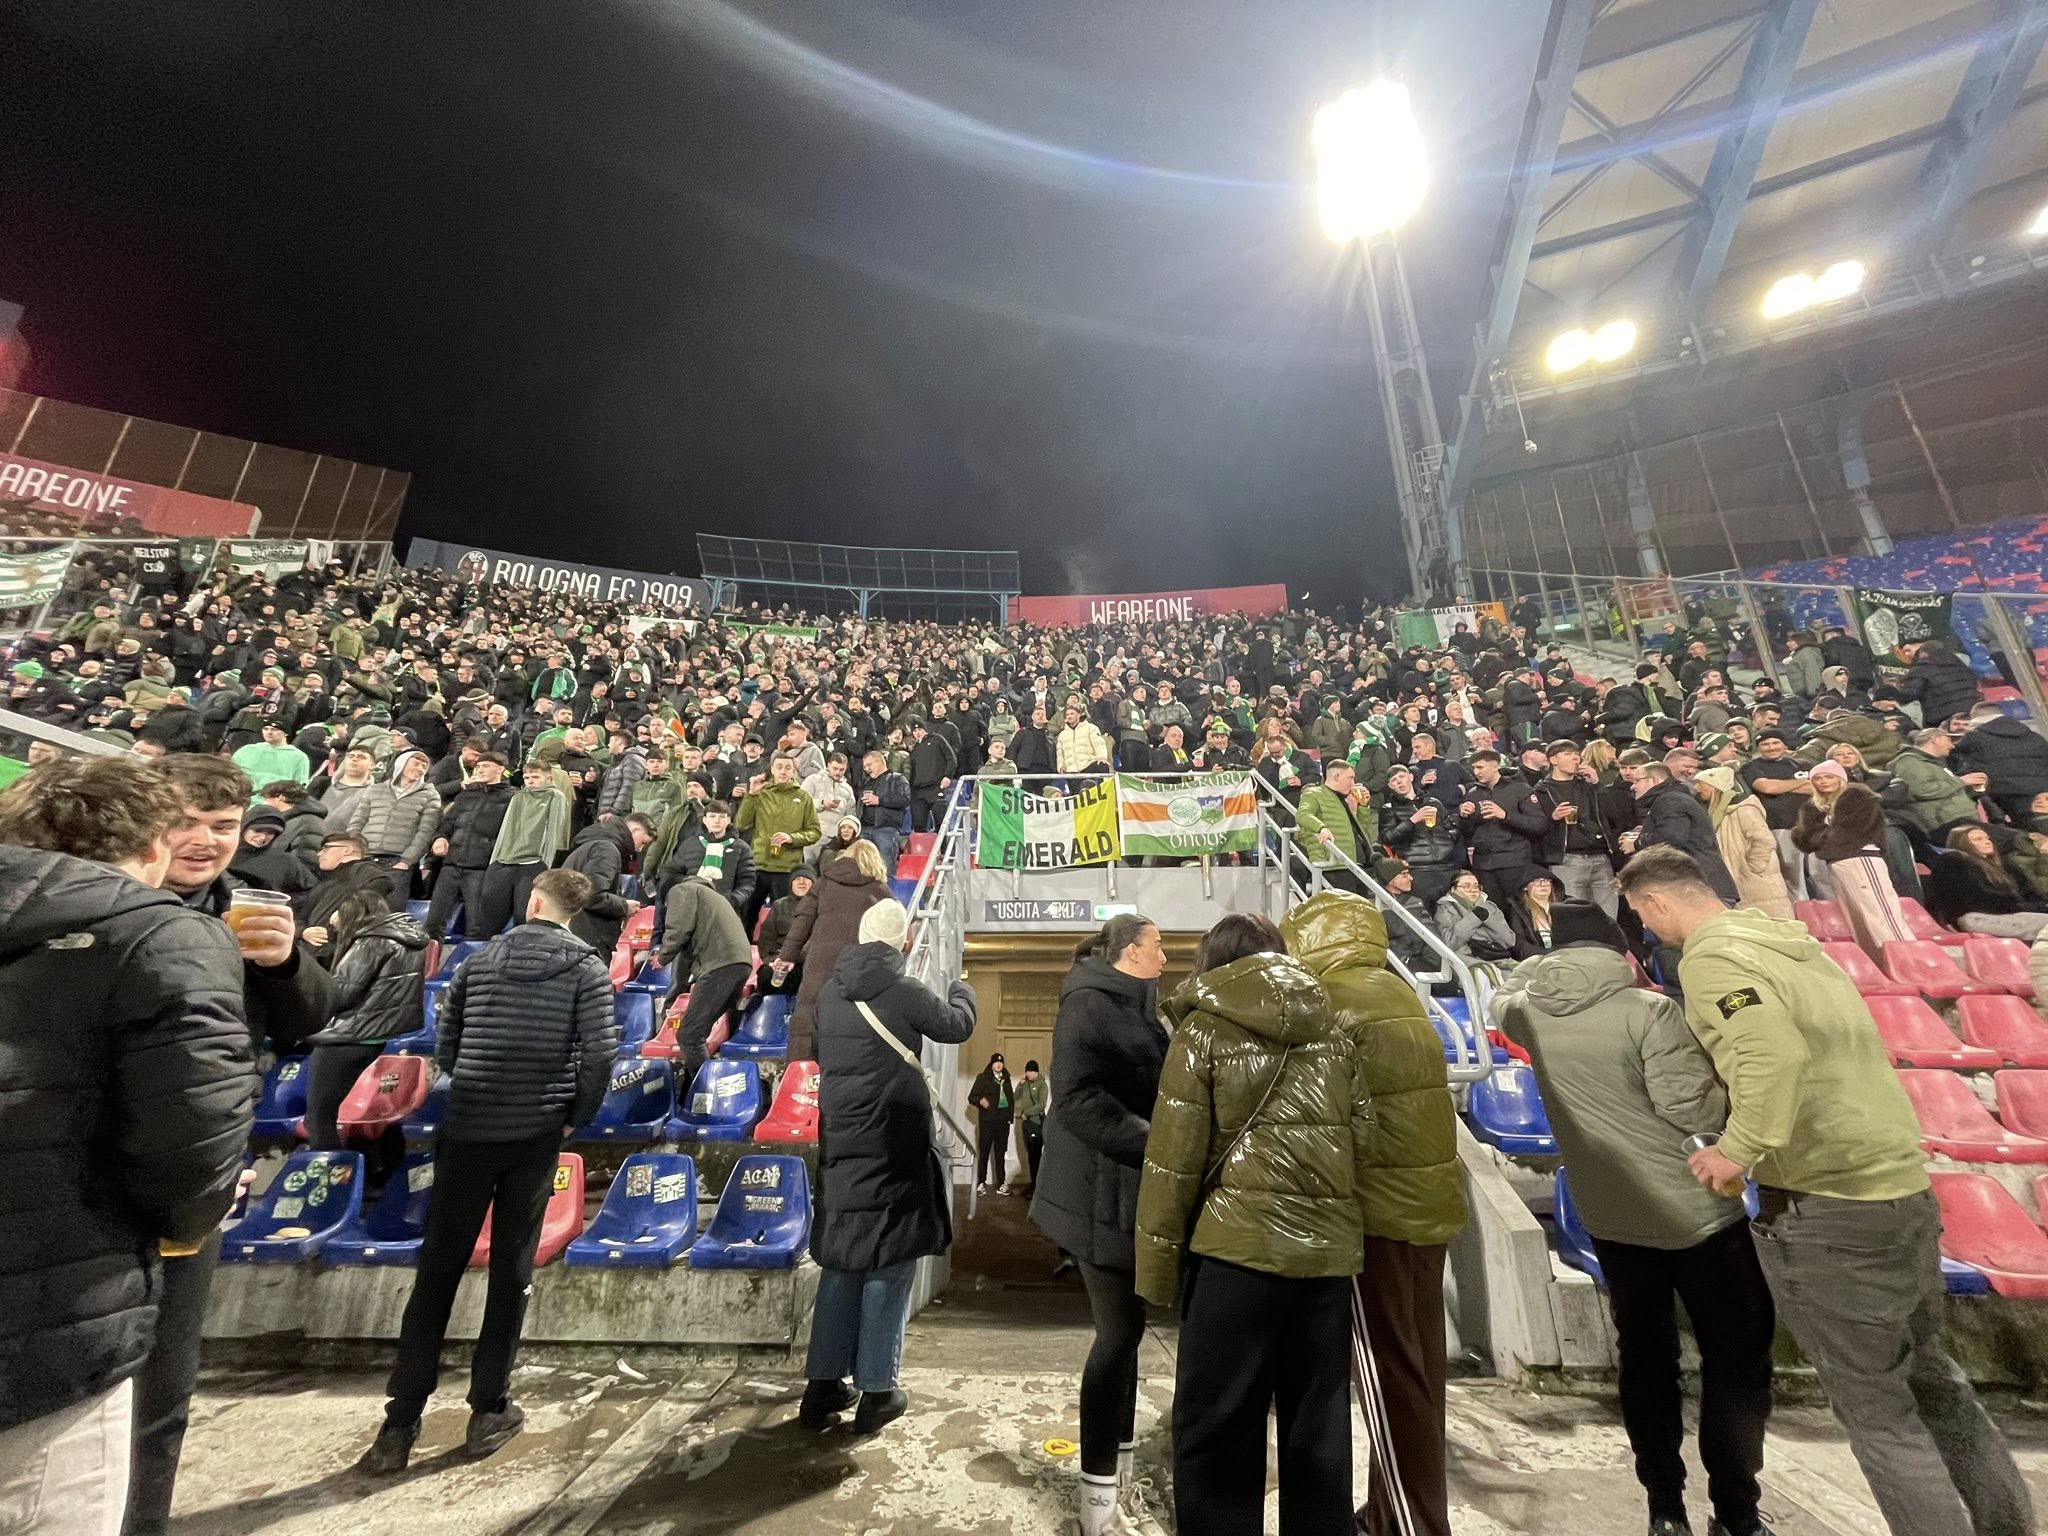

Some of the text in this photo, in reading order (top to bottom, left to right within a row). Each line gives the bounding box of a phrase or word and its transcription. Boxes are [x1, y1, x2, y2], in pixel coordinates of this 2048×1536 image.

[0, 461, 134, 514] AREONE
[492, 559, 692, 607] BOLOGNA FC 1909
[1001, 784, 1108, 815] SIGHTHILL
[1002, 830, 1113, 867] EMERALD
[997, 901, 1041, 919] USCITA
